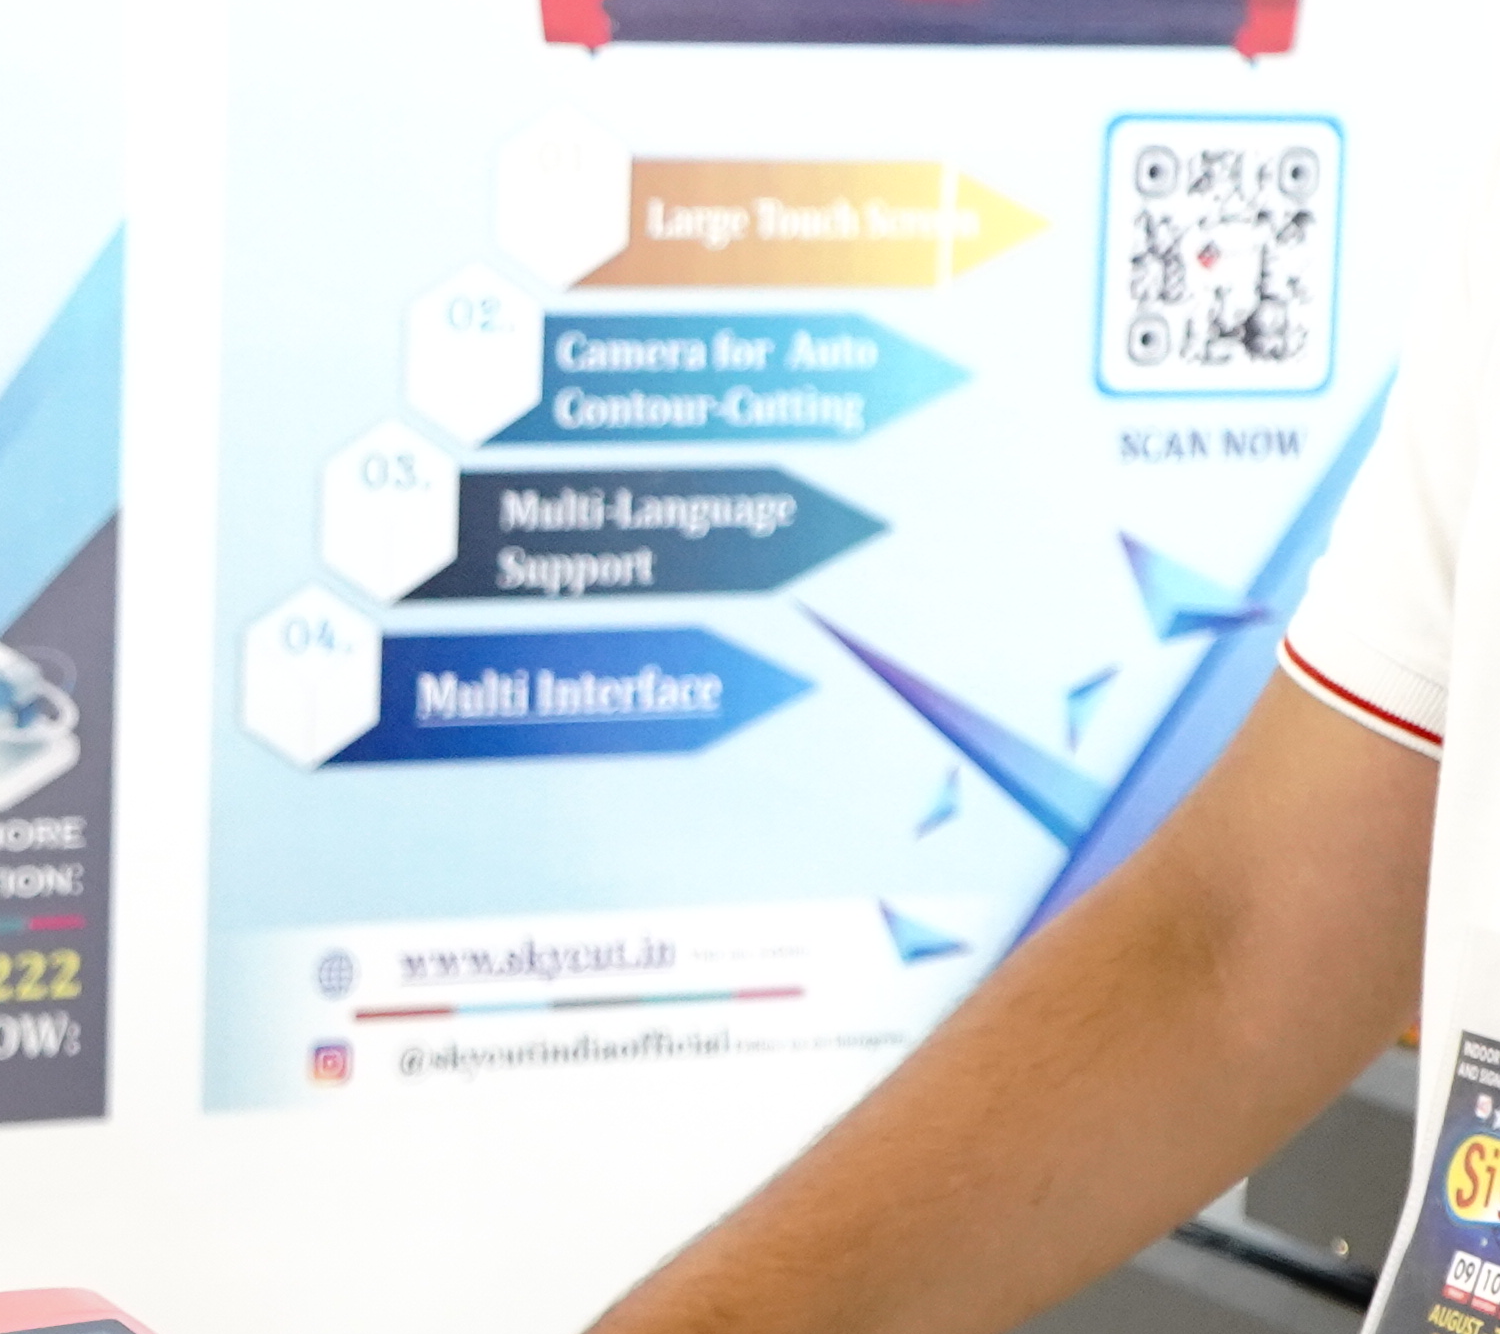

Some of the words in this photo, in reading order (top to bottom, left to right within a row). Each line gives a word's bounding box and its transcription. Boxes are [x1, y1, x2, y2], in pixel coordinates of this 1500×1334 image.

[646, 197, 749, 253] Large
[753, 195, 860, 241] Touch
[554, 328, 708, 373] Camera
[711, 325, 775, 372] for
[783, 328, 879, 370] Auto
[553, 383, 866, 434] Contour-Cutting
[1119, 427, 1211, 464] SCAN
[1220, 425, 1308, 462] NOW
[500, 486, 798, 540] Multi-Language
[495, 544, 657, 598] Support
[416, 667, 531, 721] Multi
[534, 664, 724, 716] Interface
[1457, 1061, 1480, 1081] AND
[1463, 1040, 1500, 1066] INDOOR
[1453, 1258, 1476, 1285] 09
